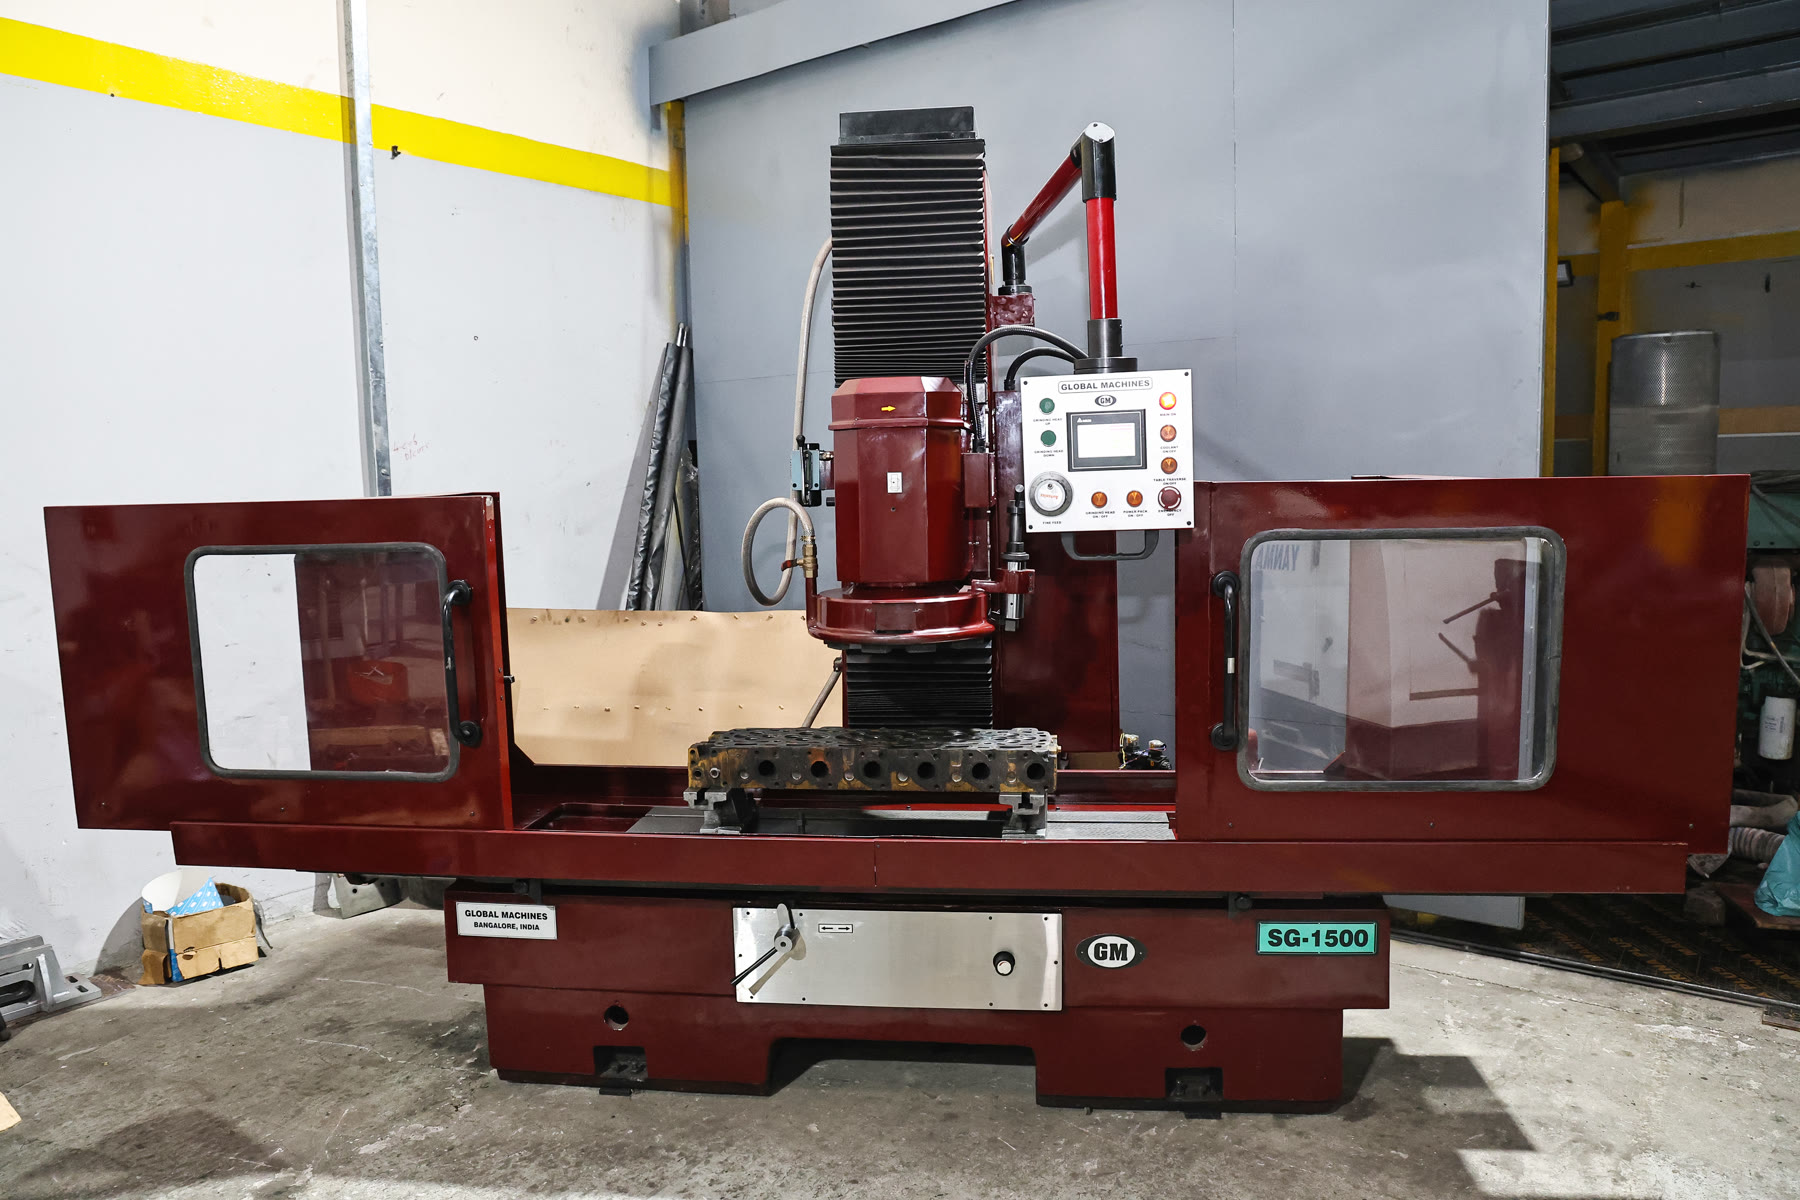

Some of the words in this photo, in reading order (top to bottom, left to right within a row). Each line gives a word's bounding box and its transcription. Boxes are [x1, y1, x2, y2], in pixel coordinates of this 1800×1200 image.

[1061, 382, 1098, 391] GLOBAL
[1100, 380, 1150, 389] MACHINES
[465, 909, 499, 919] GLOBAL
[501, 911, 548, 920] MACHINES
[473, 921, 519, 930] BANGALORE,
[1267, 928, 1369, 948] SG-1500
[1093, 943, 1128, 961] GM
[1711, 966, 1757, 990] PLUS
